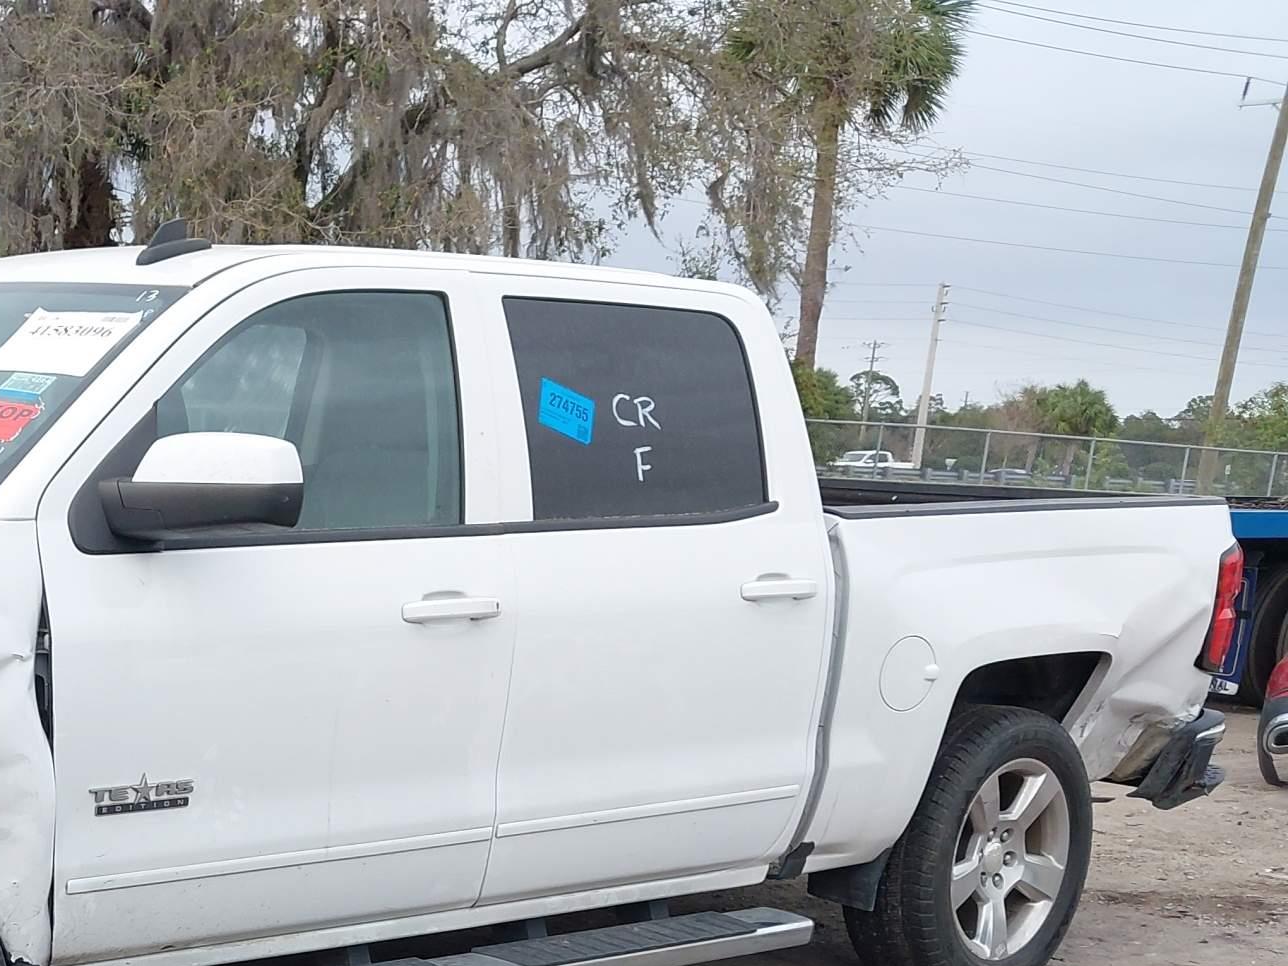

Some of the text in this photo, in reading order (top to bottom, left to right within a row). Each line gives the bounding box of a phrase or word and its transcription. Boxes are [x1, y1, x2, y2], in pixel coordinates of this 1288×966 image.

[135, 289, 160, 303] 13
[29, 325, 113, 338] 41583096
[548, 391, 589, 423] 274755
[611, 393, 663, 431] CR
[632, 445, 653, 482] F
[100, 799, 185, 815] EDITION
